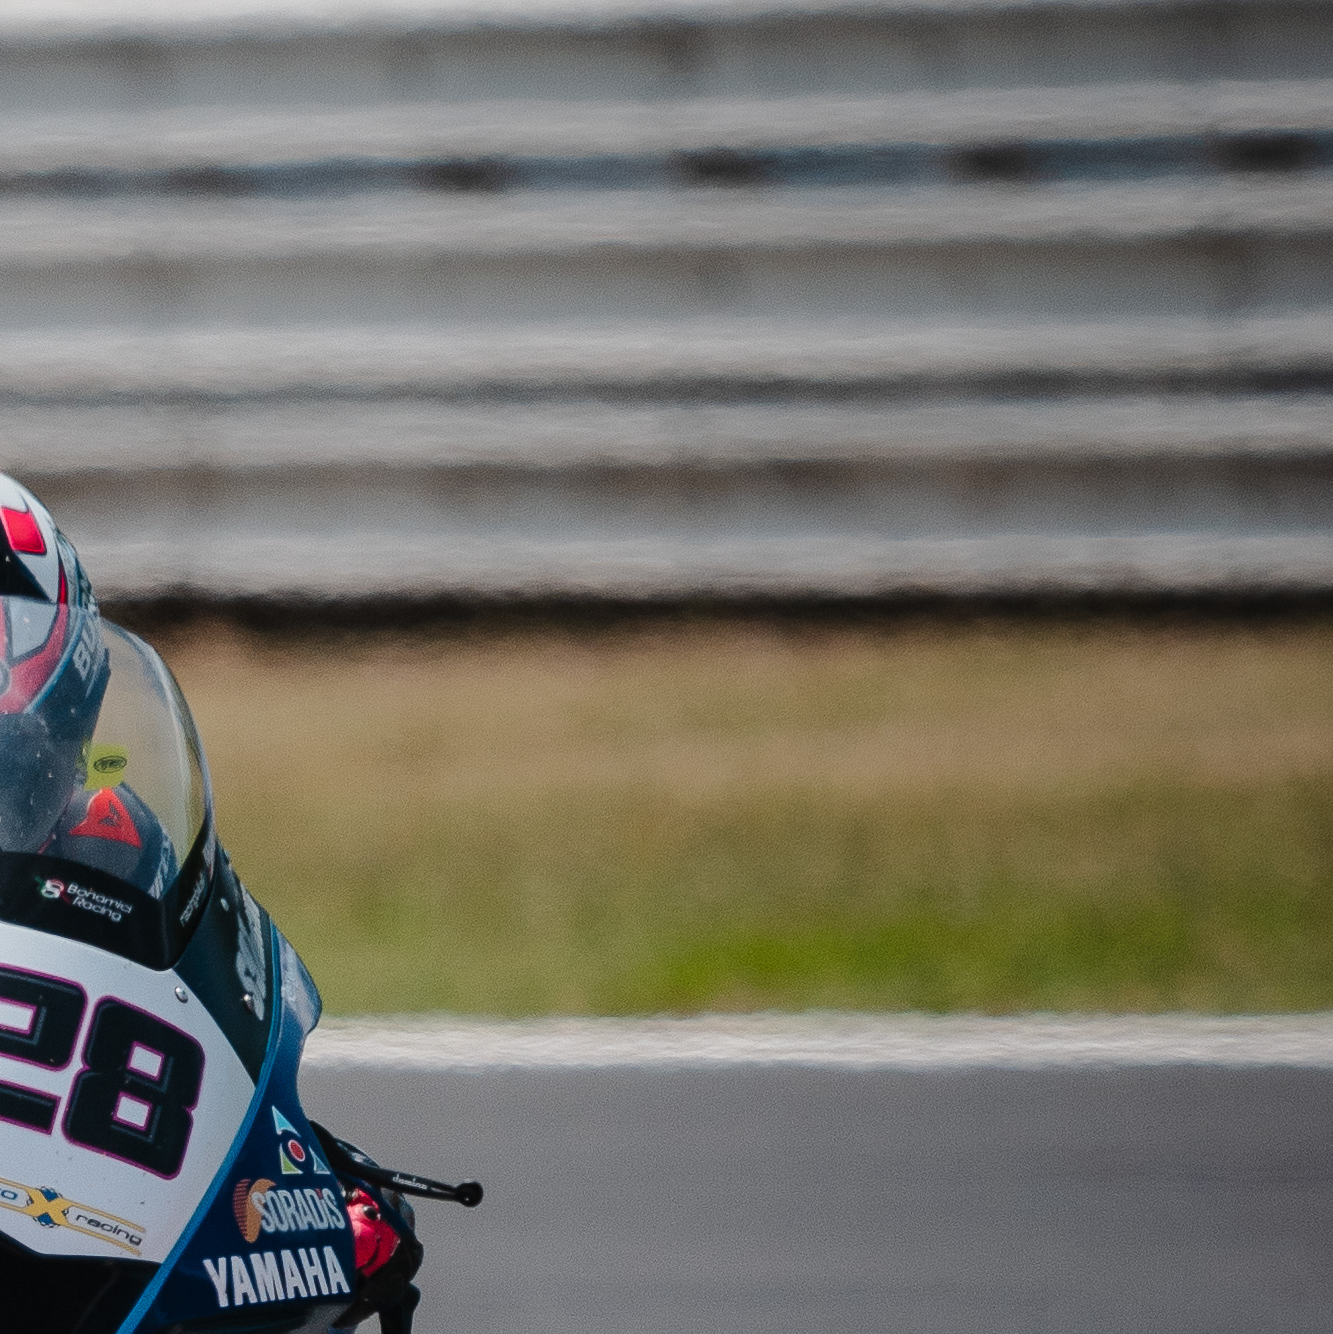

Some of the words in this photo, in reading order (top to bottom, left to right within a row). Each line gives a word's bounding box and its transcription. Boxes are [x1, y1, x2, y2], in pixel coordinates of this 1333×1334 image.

[66, 882, 133, 914] Bonamici
[71, 897, 123, 923] Racing
[75, 1213, 142, 1246] racing
[202, 1245, 351, 1308] YAMAHA
